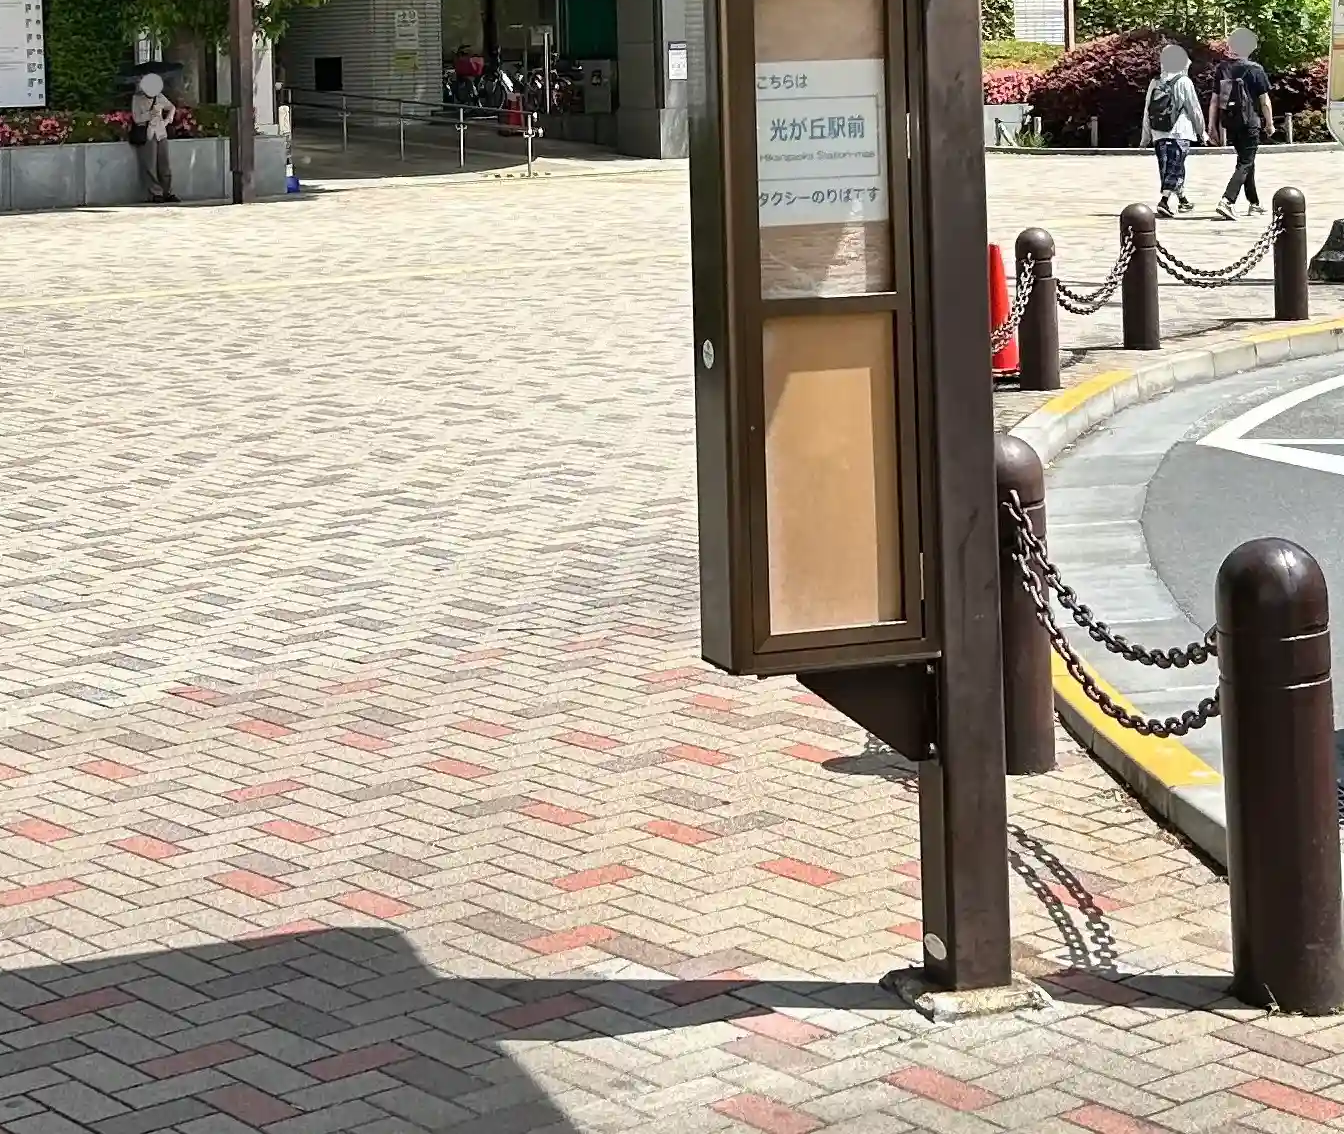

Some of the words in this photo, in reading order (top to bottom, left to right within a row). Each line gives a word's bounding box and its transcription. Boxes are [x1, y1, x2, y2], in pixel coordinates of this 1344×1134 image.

[757, 74, 808, 90] こちらは
[769, 114, 865, 142] 光が丘駅前
